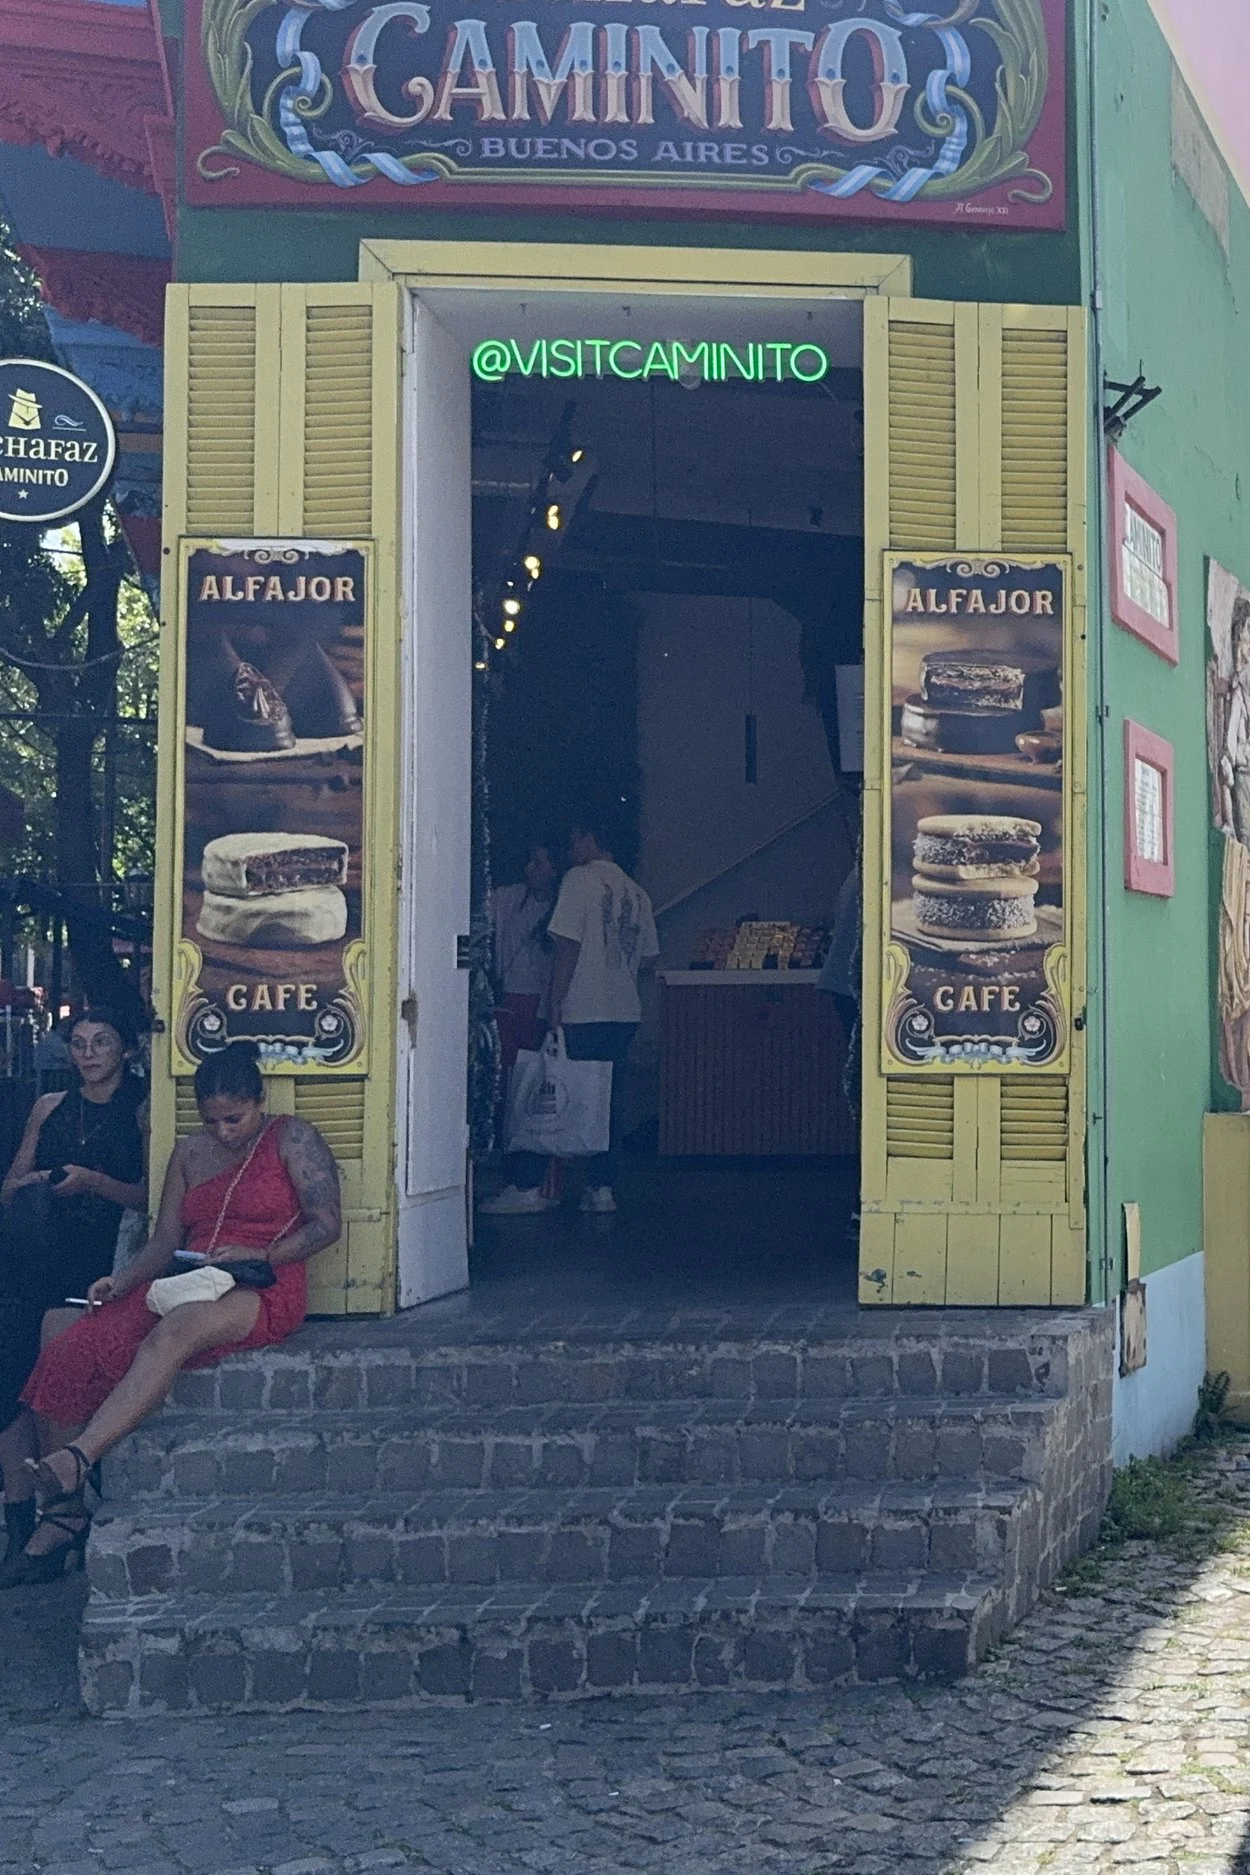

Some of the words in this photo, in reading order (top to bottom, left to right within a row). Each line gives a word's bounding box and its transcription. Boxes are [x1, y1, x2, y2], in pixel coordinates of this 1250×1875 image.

[341, 2, 911, 143] CAMINITO
[479, 137, 639, 162] BUENOS
[653, 140, 770, 165] AIRES
[471, 338, 829, 383] @VISITCAMINITO
[200, 575, 356, 602] ALFAJOR
[905, 587, 1055, 616] ALFAJOR
[226, 983, 319, 1011] CAFE
[934, 985, 1021, 1012] CAFE
